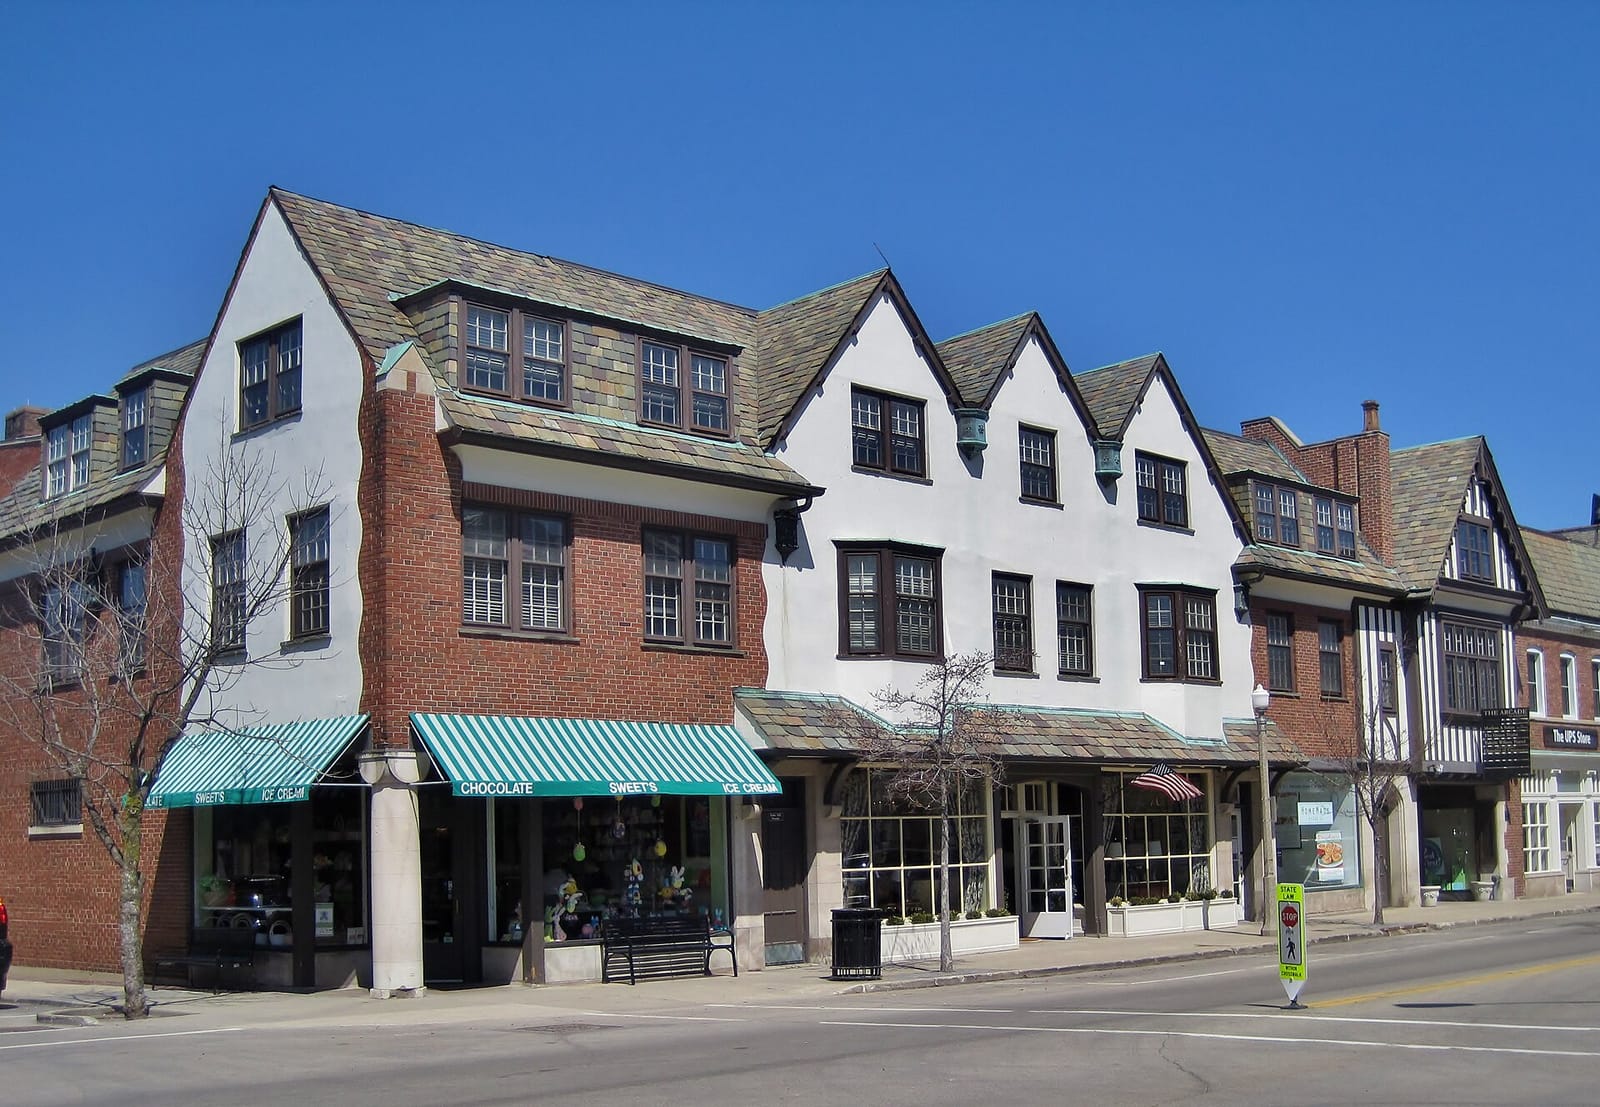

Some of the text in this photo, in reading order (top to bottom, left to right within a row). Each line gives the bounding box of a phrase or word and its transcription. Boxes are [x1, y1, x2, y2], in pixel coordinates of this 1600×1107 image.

[1500, 708, 1526, 716] ARCADE
[1553, 729, 1591, 745] The UPS Store
[195, 791, 225, 804] SWEET'S
[262, 788, 274, 801] ICE
[277, 786, 304, 800] CREAM
[461, 781, 779, 795] CHOCOLATE SWEET'S ICE CREAM
[1282, 912, 1298, 921] STOP
